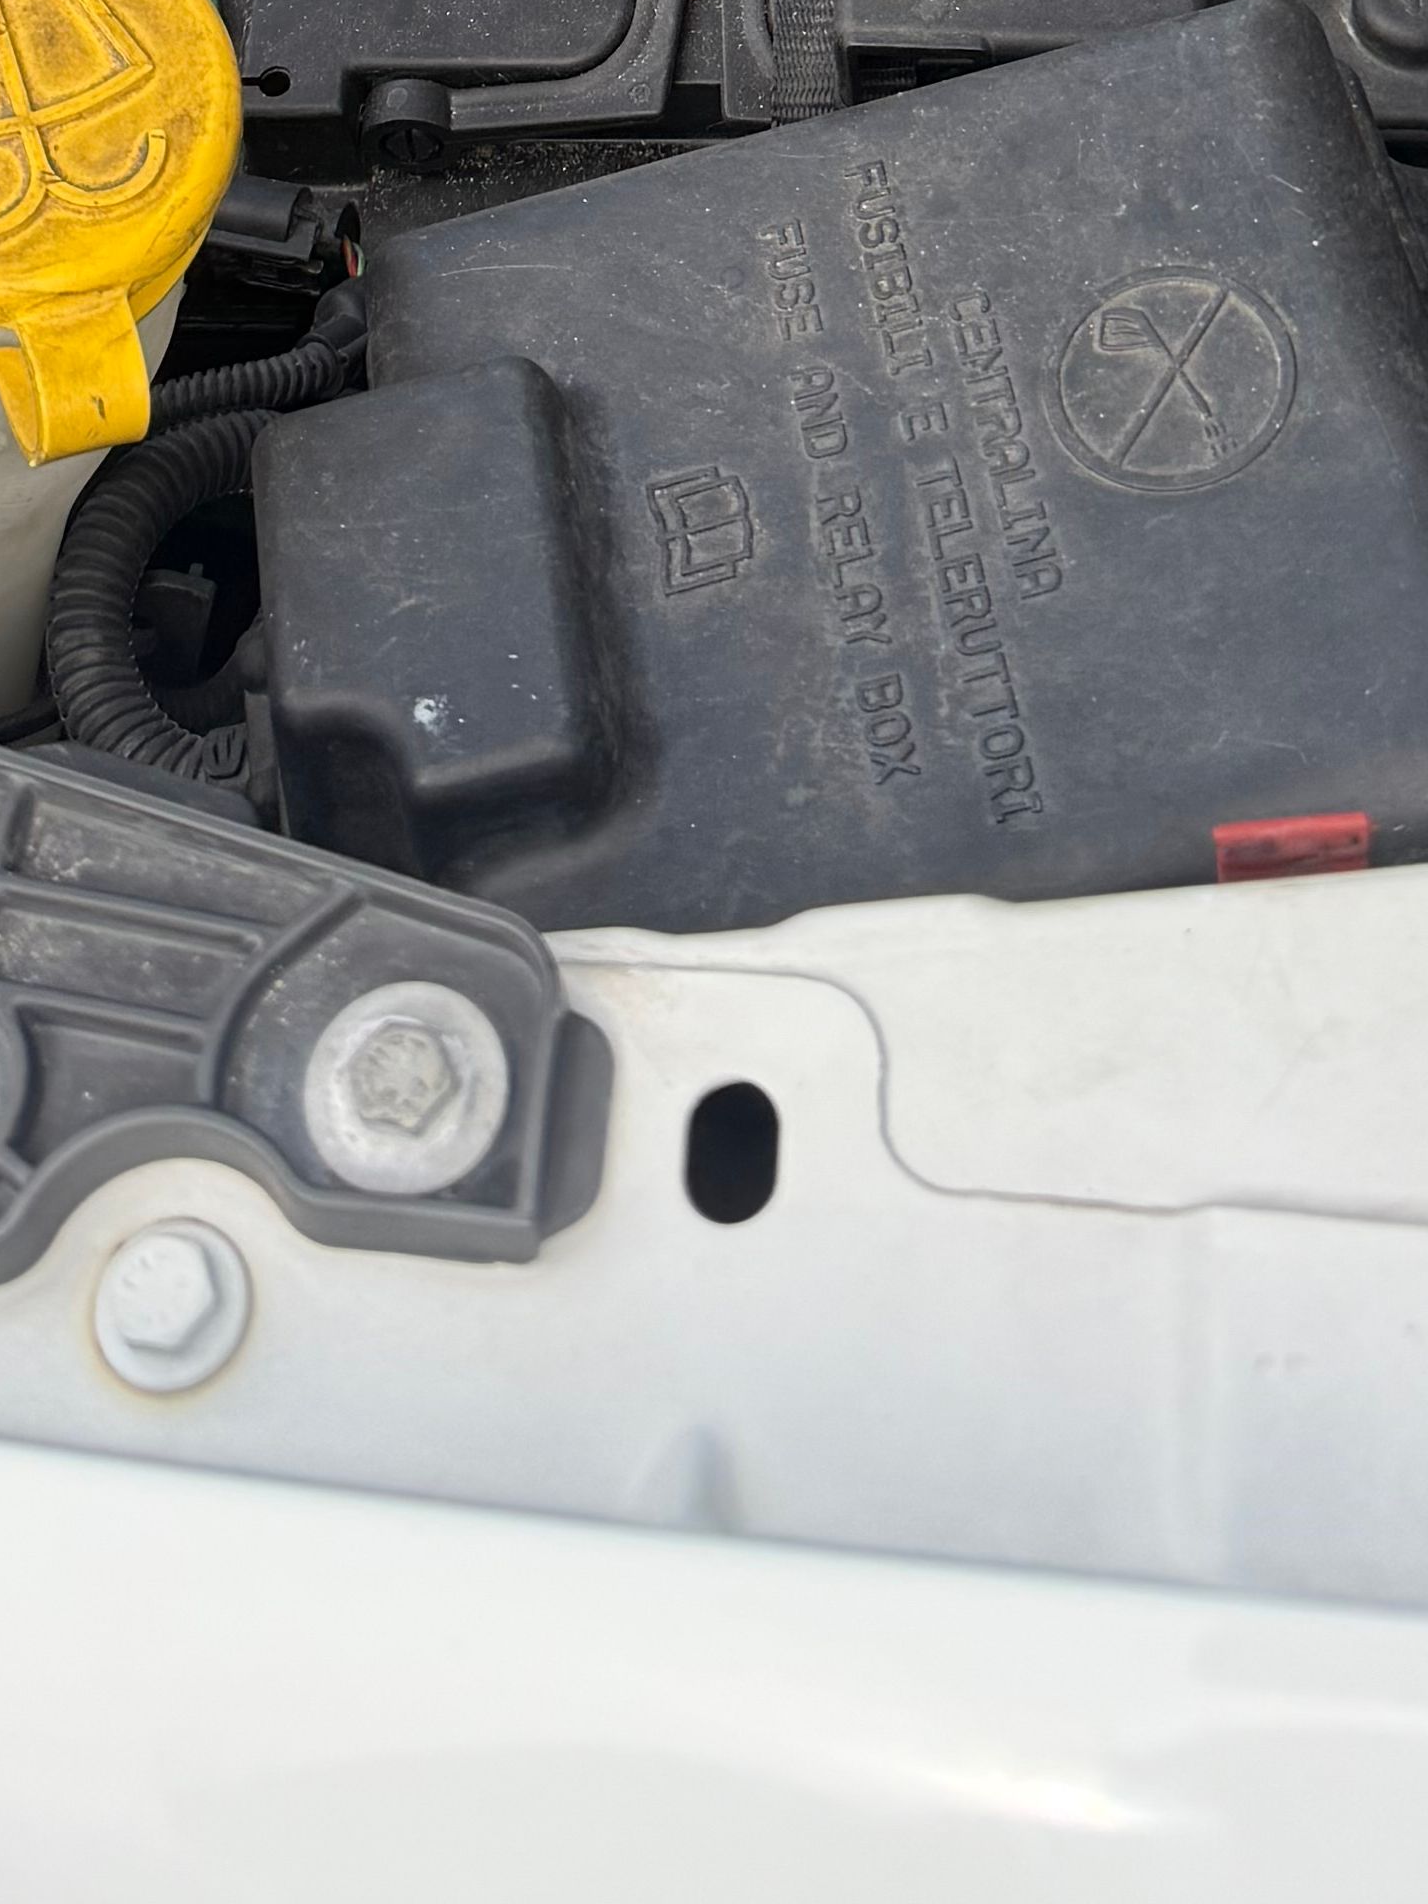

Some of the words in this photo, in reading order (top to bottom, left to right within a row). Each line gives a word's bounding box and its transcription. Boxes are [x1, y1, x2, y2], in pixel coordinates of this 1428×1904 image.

[755, 216, 827, 344] FUSE
[842, 157, 934, 377] FUSIBILI
[785, 364, 851, 462] AND
[900, 400, 950, 442] E
[945, 289, 1064, 603] CENTRALINA
[815, 482, 893, 646] RELAY
[915, 460, 1045, 826] TELERUTTORI
[854, 671, 923, 787] BOX
